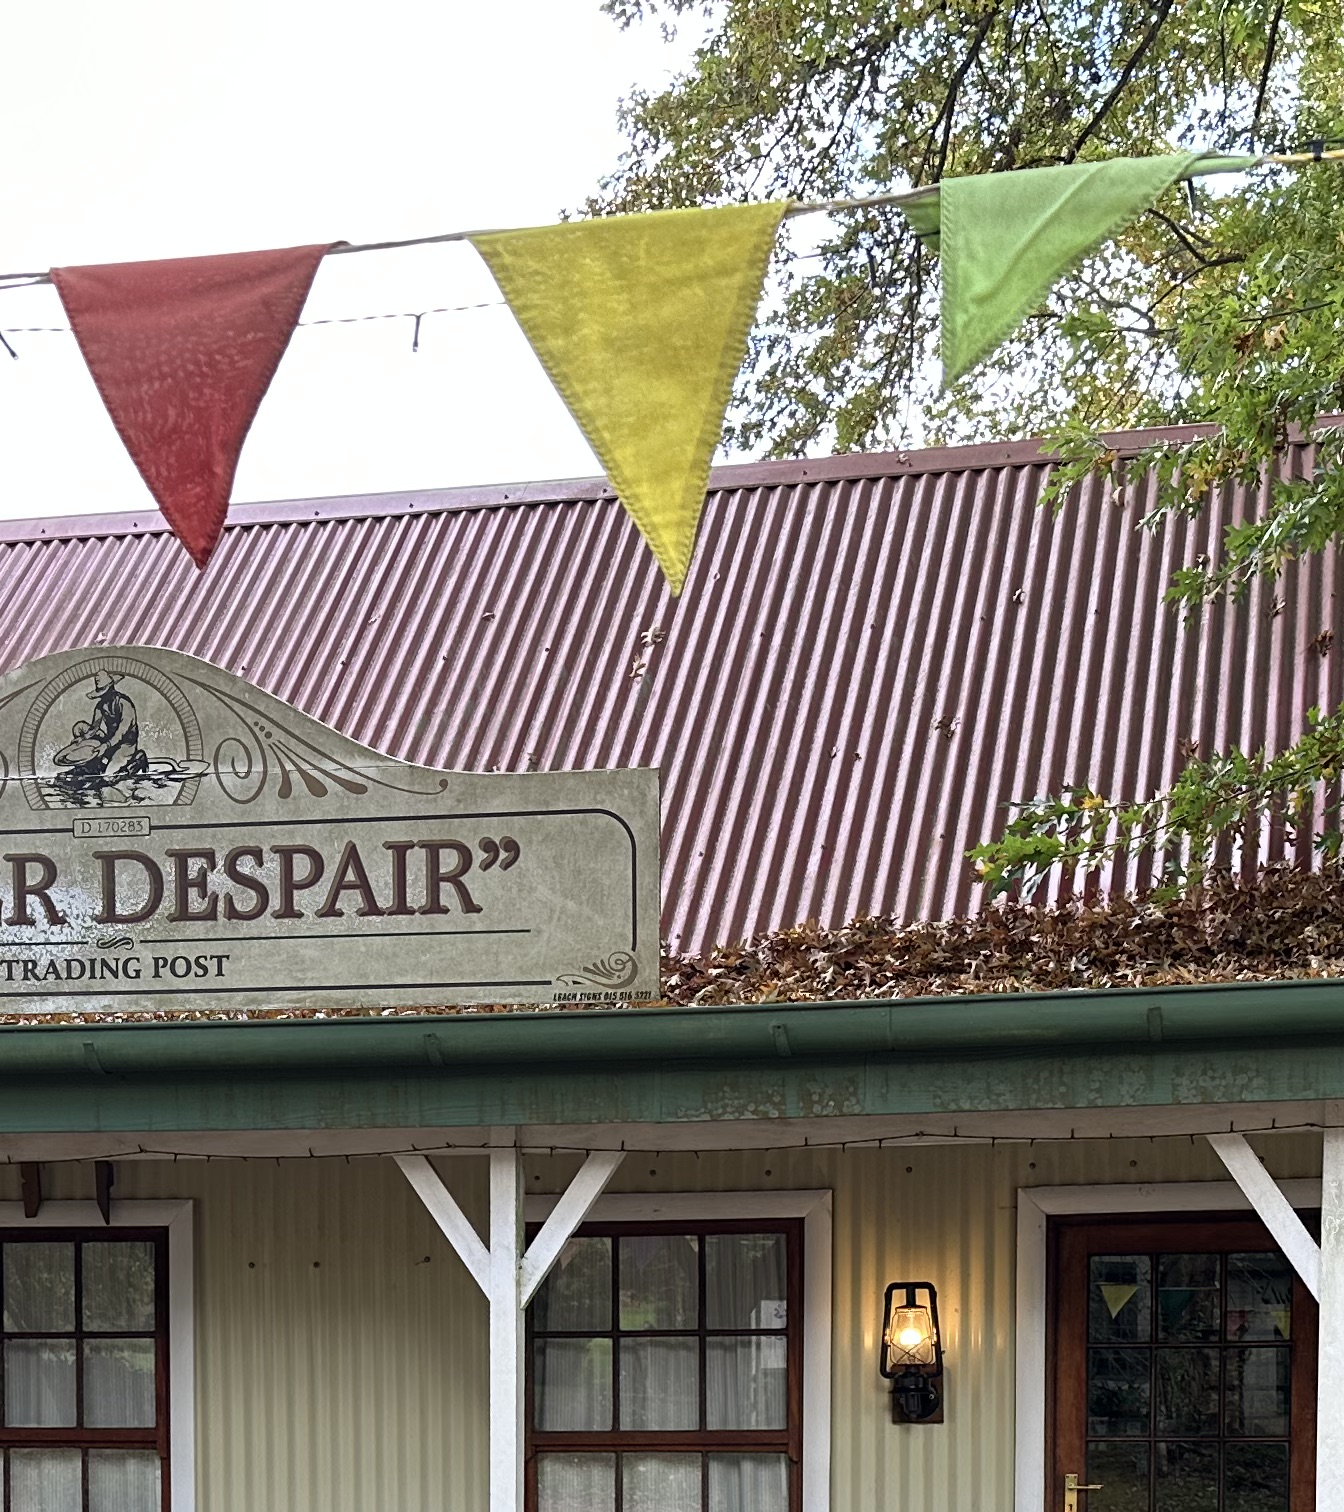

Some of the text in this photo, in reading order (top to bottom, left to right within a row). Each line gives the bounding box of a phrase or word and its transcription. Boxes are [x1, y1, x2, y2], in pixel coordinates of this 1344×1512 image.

[80, 820, 144, 834] D 170283
[0, 955, 231, 982] TRADING POST
[579, 992, 602, 1002] SIGNS
